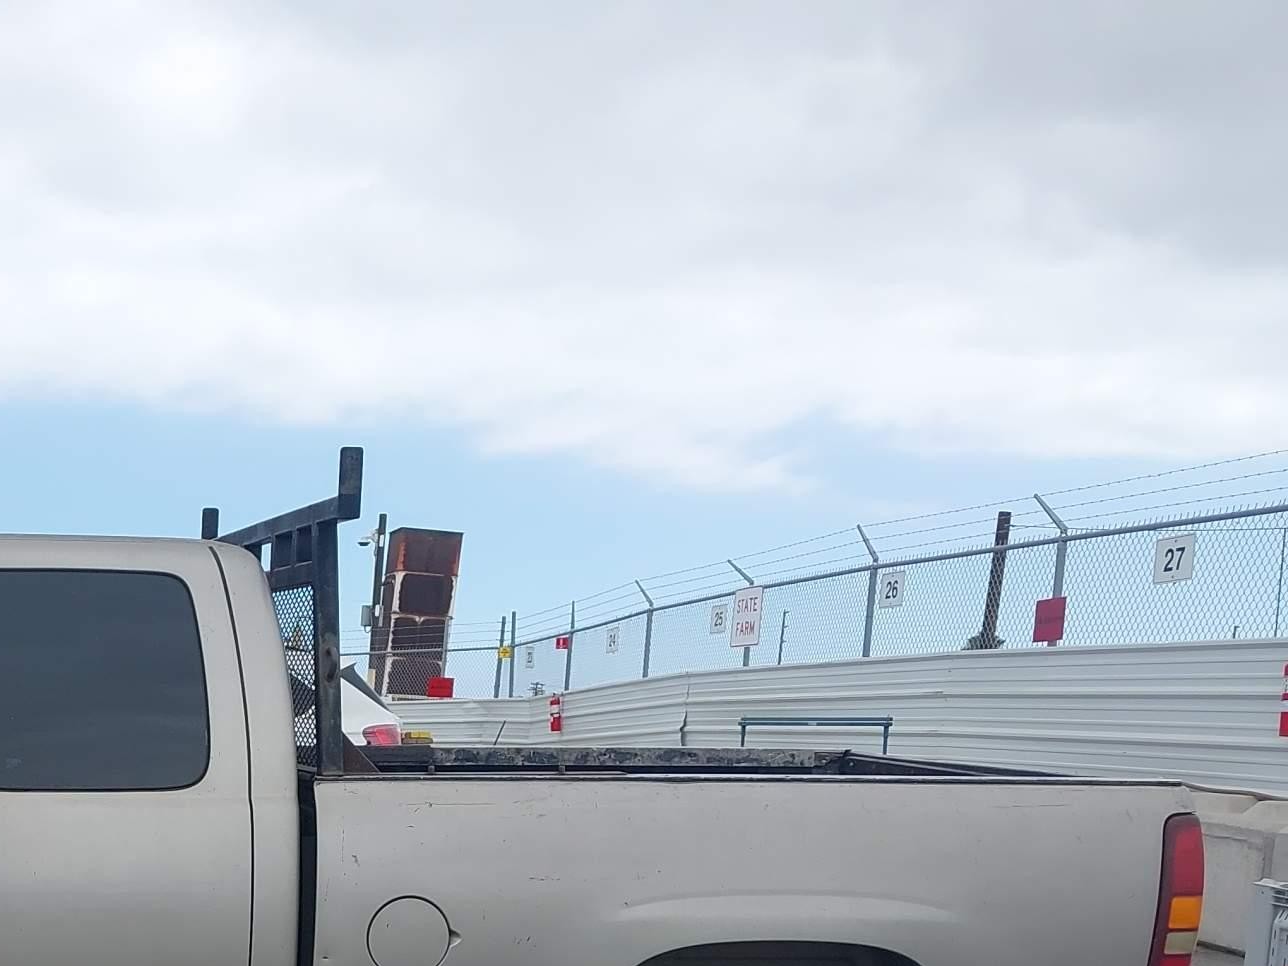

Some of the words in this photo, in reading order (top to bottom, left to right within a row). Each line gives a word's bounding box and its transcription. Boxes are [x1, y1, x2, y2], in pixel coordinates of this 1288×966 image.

[1162, 546, 1186, 573] 27
[885, 580, 899, 600] 26
[736, 596, 759, 615] STATE
[713, 612, 724, 628] 25
[735, 620, 755, 638] FARM
